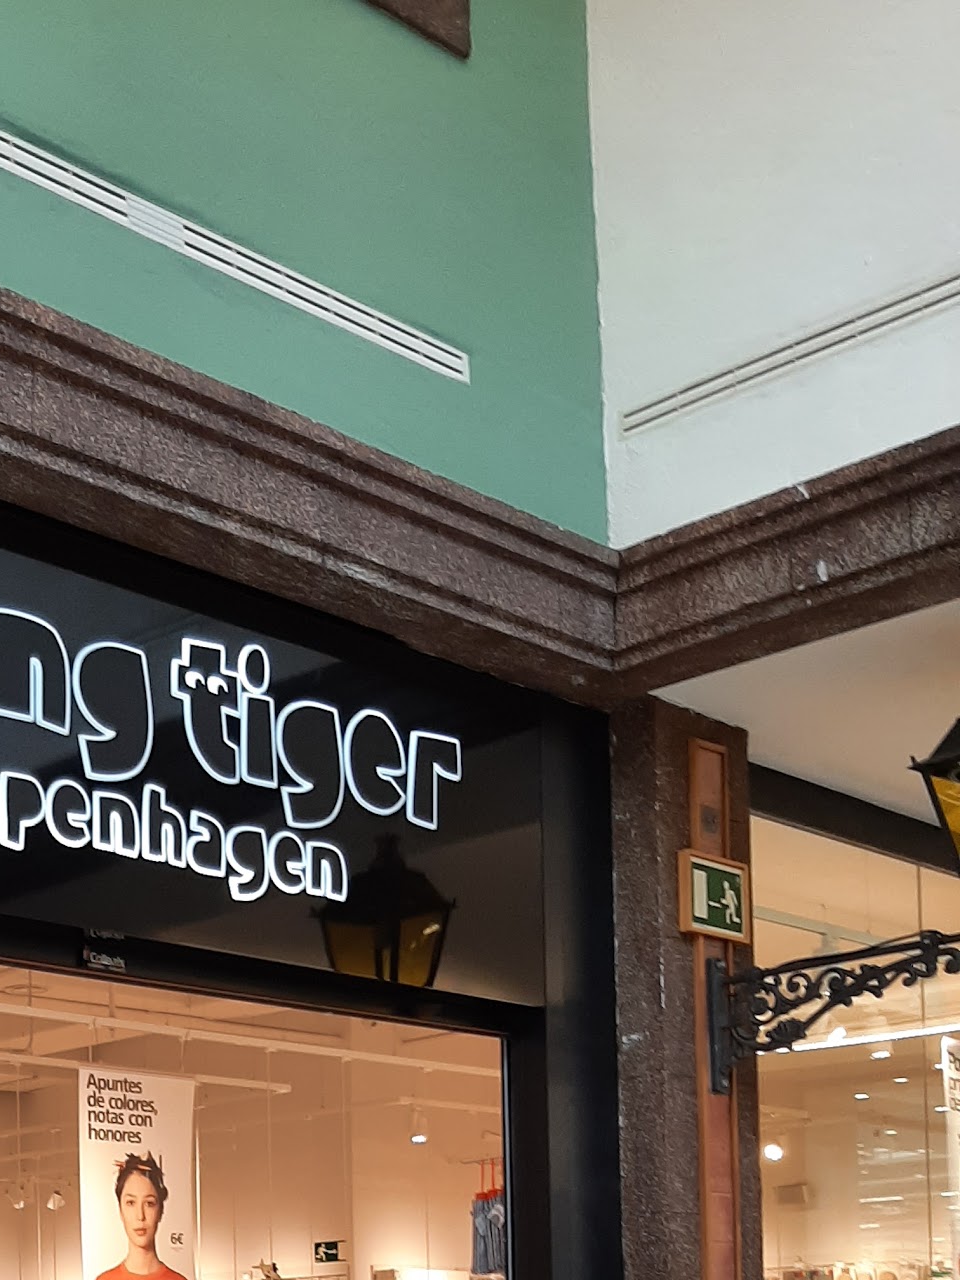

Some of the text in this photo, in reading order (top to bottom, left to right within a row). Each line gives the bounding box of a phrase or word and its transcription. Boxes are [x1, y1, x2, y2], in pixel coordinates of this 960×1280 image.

[171, 638, 463, 831] tiger
[86, 1073, 143, 1094] Apuntes
[87, 1090, 158, 1116] de colores,
[88, 1109, 153, 1128] notas con
[88, 1122, 142, 1144] honores
[170, 1232, 184, 1246] 6€
